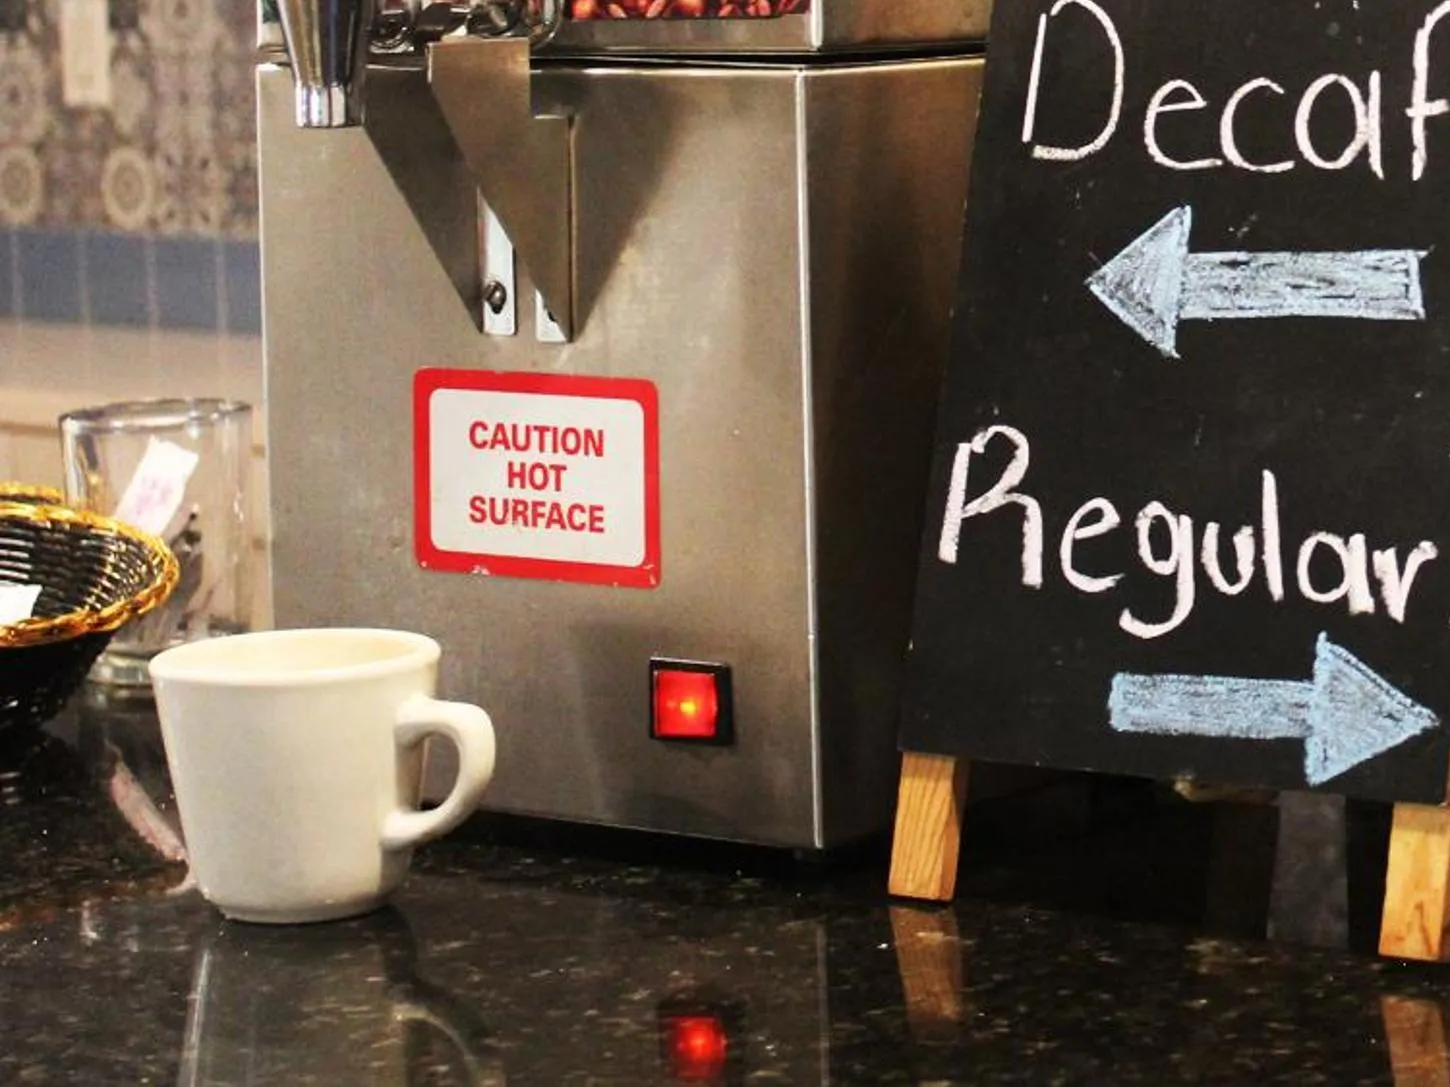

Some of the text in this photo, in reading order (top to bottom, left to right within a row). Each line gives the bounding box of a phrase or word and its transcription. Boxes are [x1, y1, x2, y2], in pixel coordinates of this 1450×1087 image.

[469, 421, 605, 457] CAUTION
[507, 461, 567, 492] HOT
[469, 495, 605, 533] SURFACE
